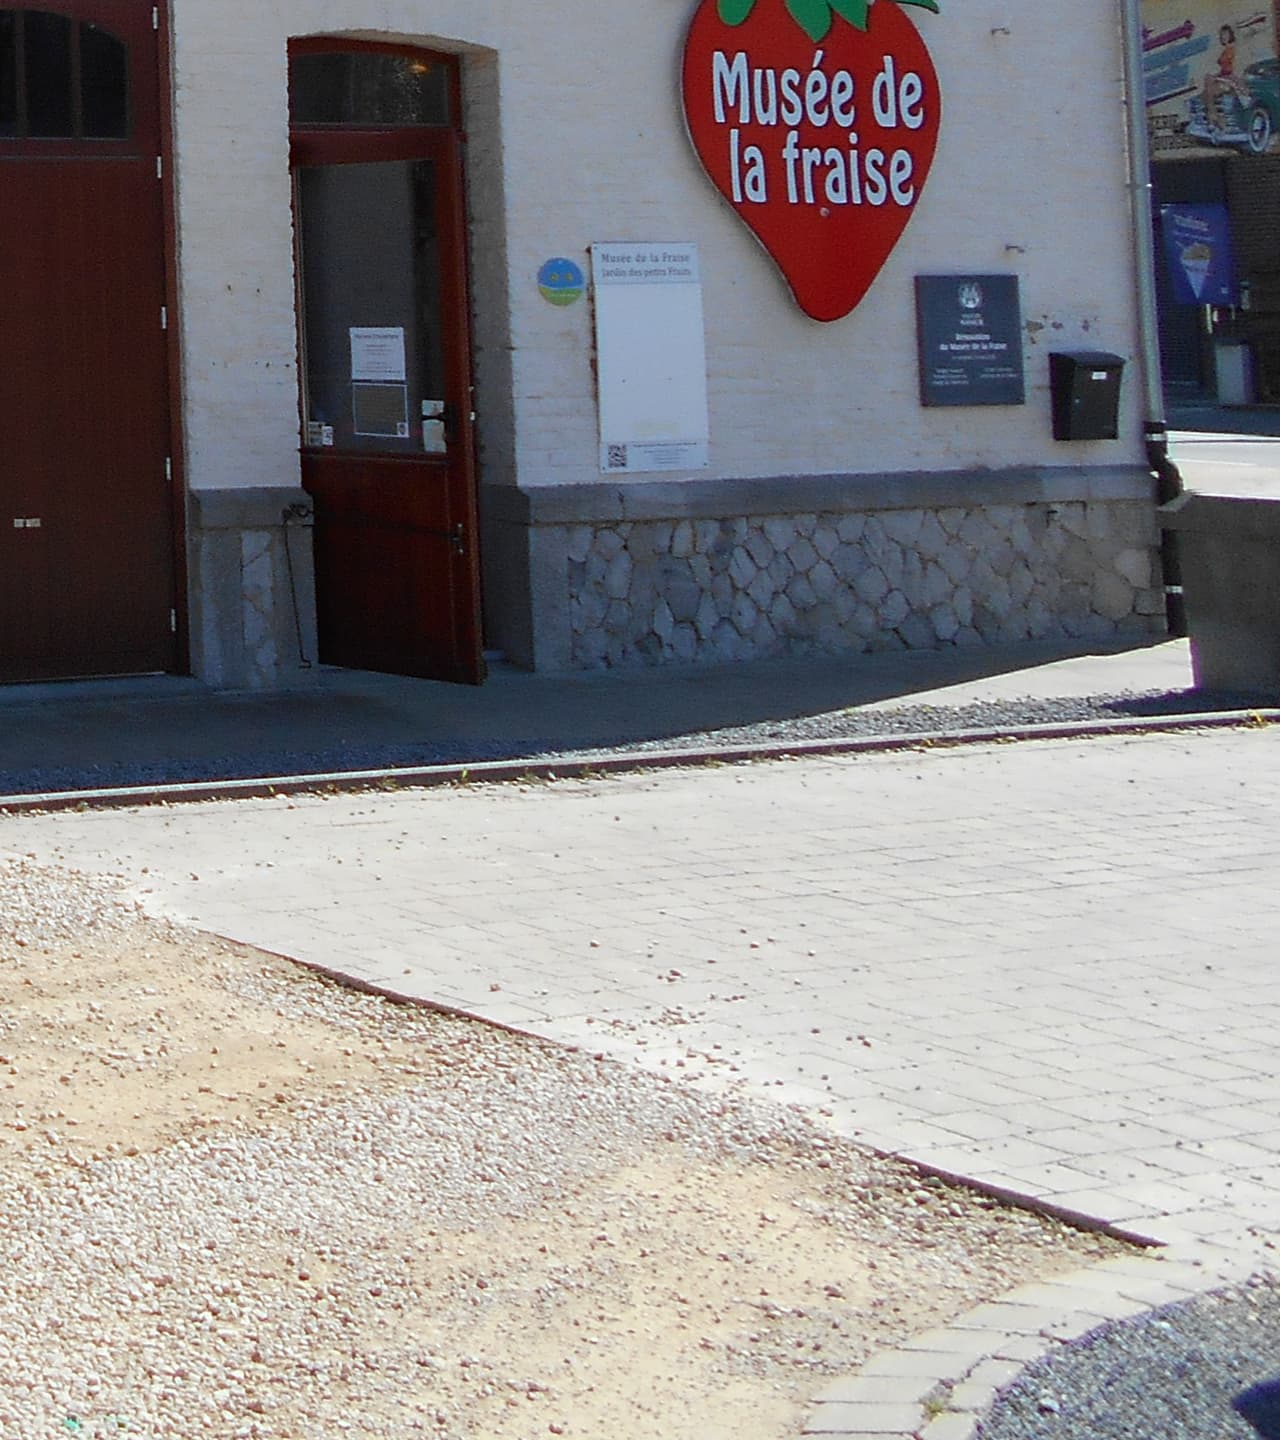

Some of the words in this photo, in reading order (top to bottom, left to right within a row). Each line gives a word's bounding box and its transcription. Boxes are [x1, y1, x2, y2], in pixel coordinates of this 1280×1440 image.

[712, 49, 856, 128] Musée
[872, 55, 924, 129] de
[729, 128, 768, 203] la
[781, 129, 915, 206] fraise
[601, 252, 632, 264] Musée
[635, 253, 646, 263] de
[649, 253, 659, 263] la
[662, 252, 690, 263] Fraise
